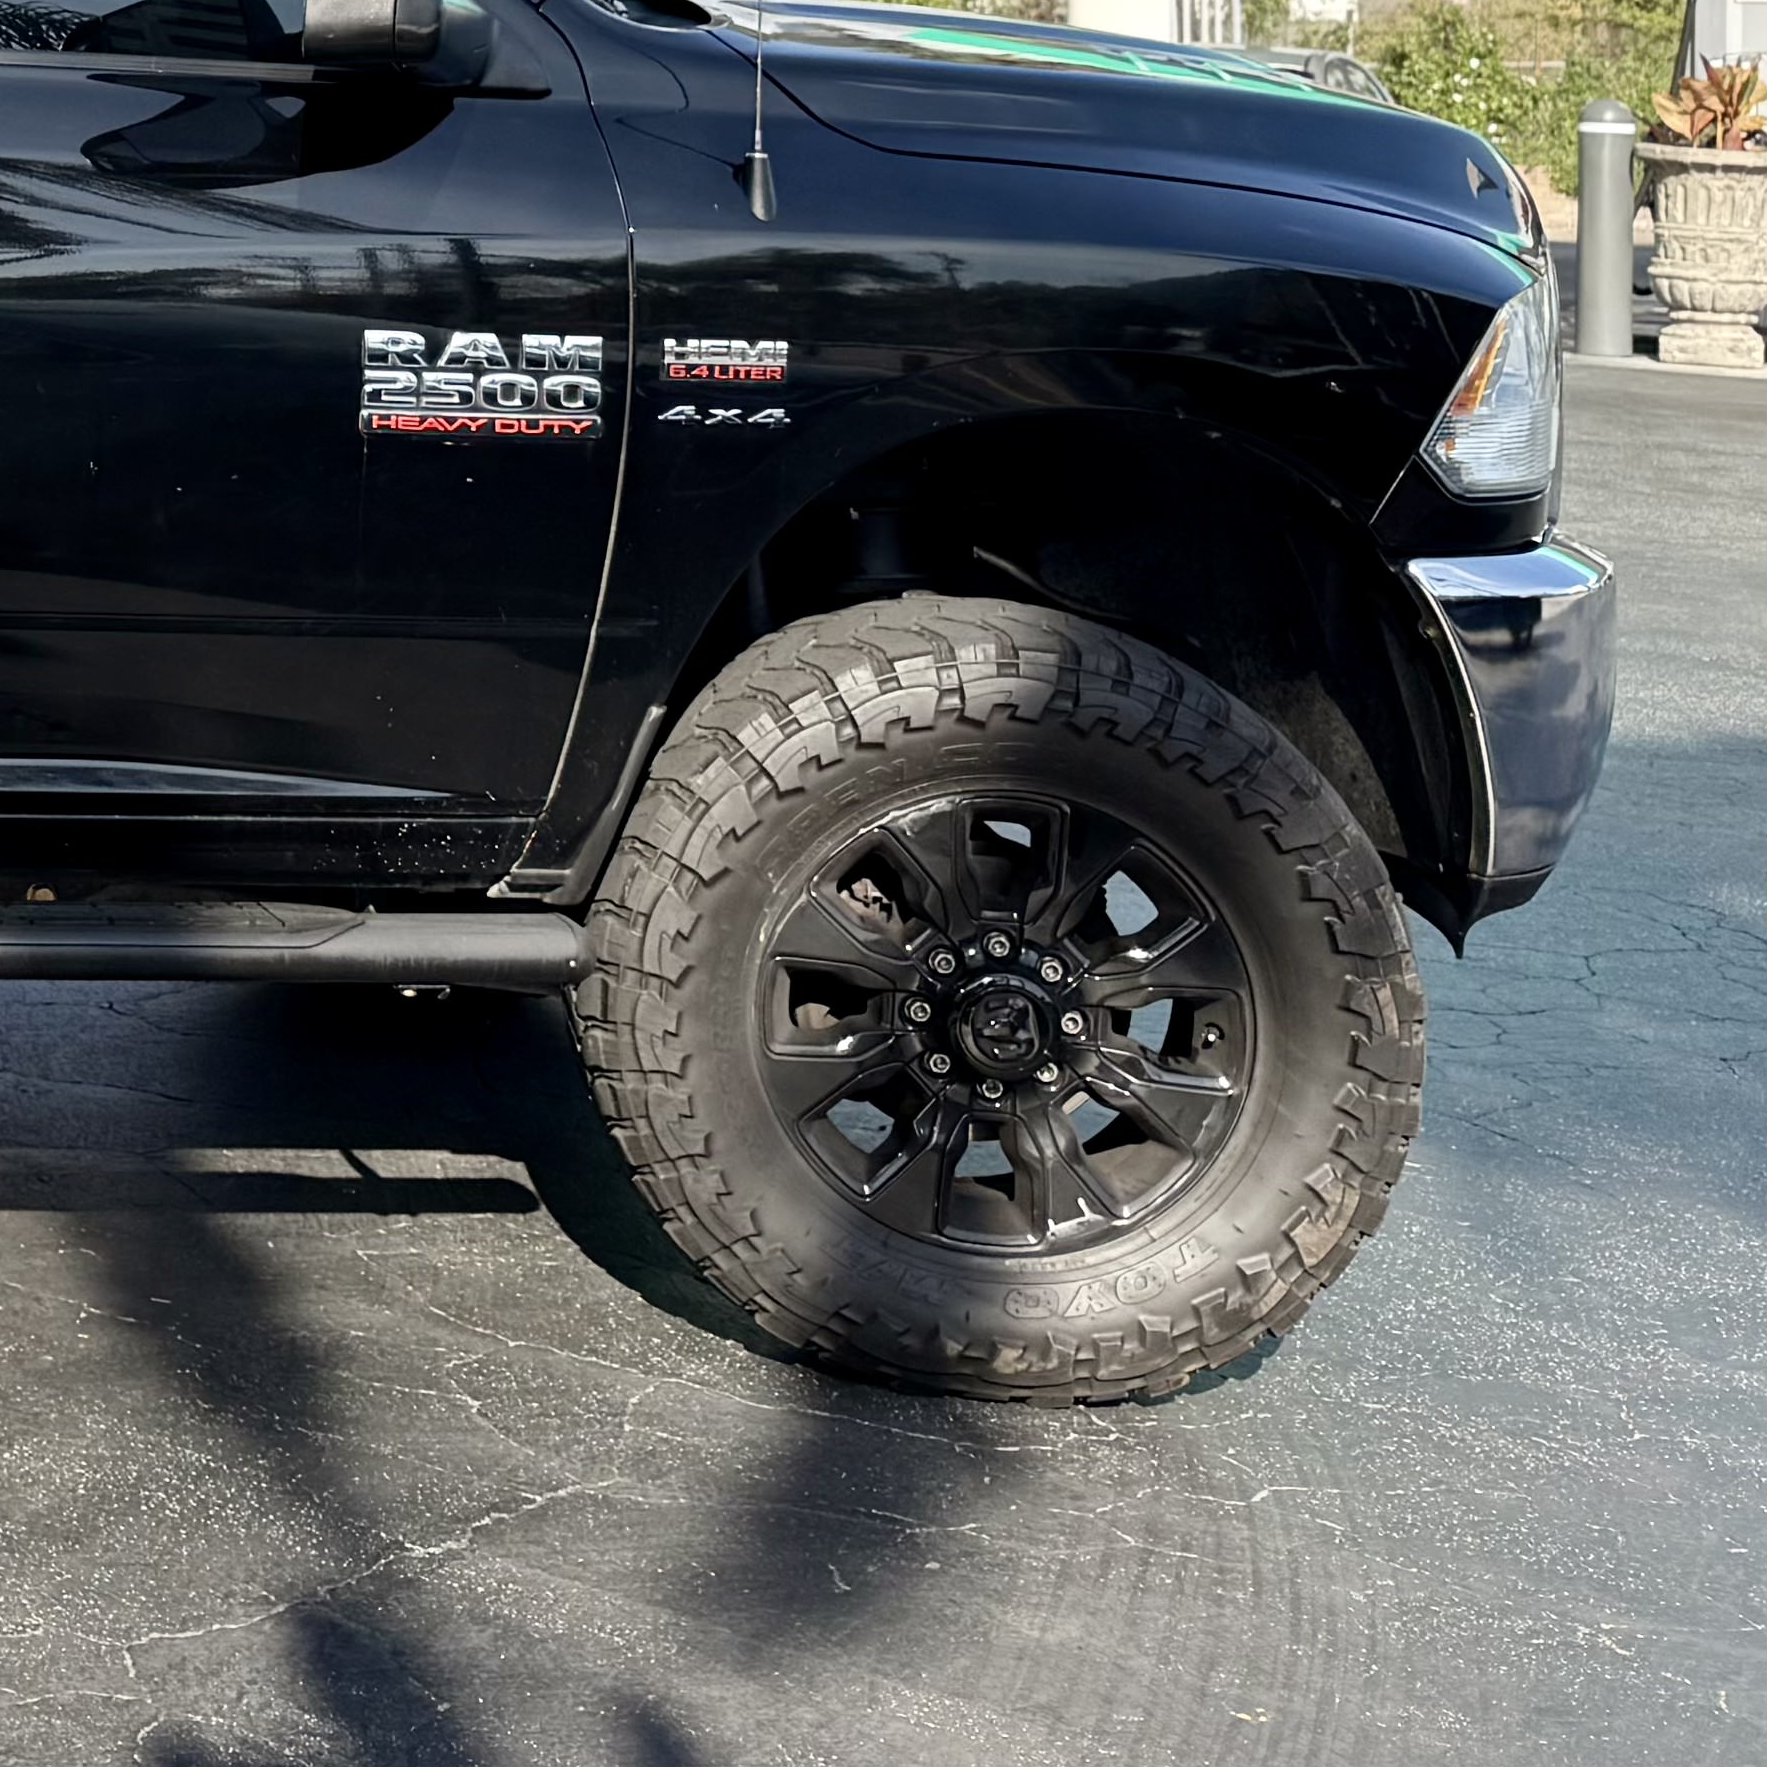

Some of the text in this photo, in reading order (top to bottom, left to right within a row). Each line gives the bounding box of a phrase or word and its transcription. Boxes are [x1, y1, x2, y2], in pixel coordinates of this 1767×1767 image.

[364, 329, 604, 371] RAM
[663, 338, 789, 364] HEMI
[669, 364, 783, 380] 6.4 LITER
[362, 370, 602, 413] 2500
[371, 414, 593, 435] HEAVY DUTY
[1004, 1236, 1221, 1321] TOYO
